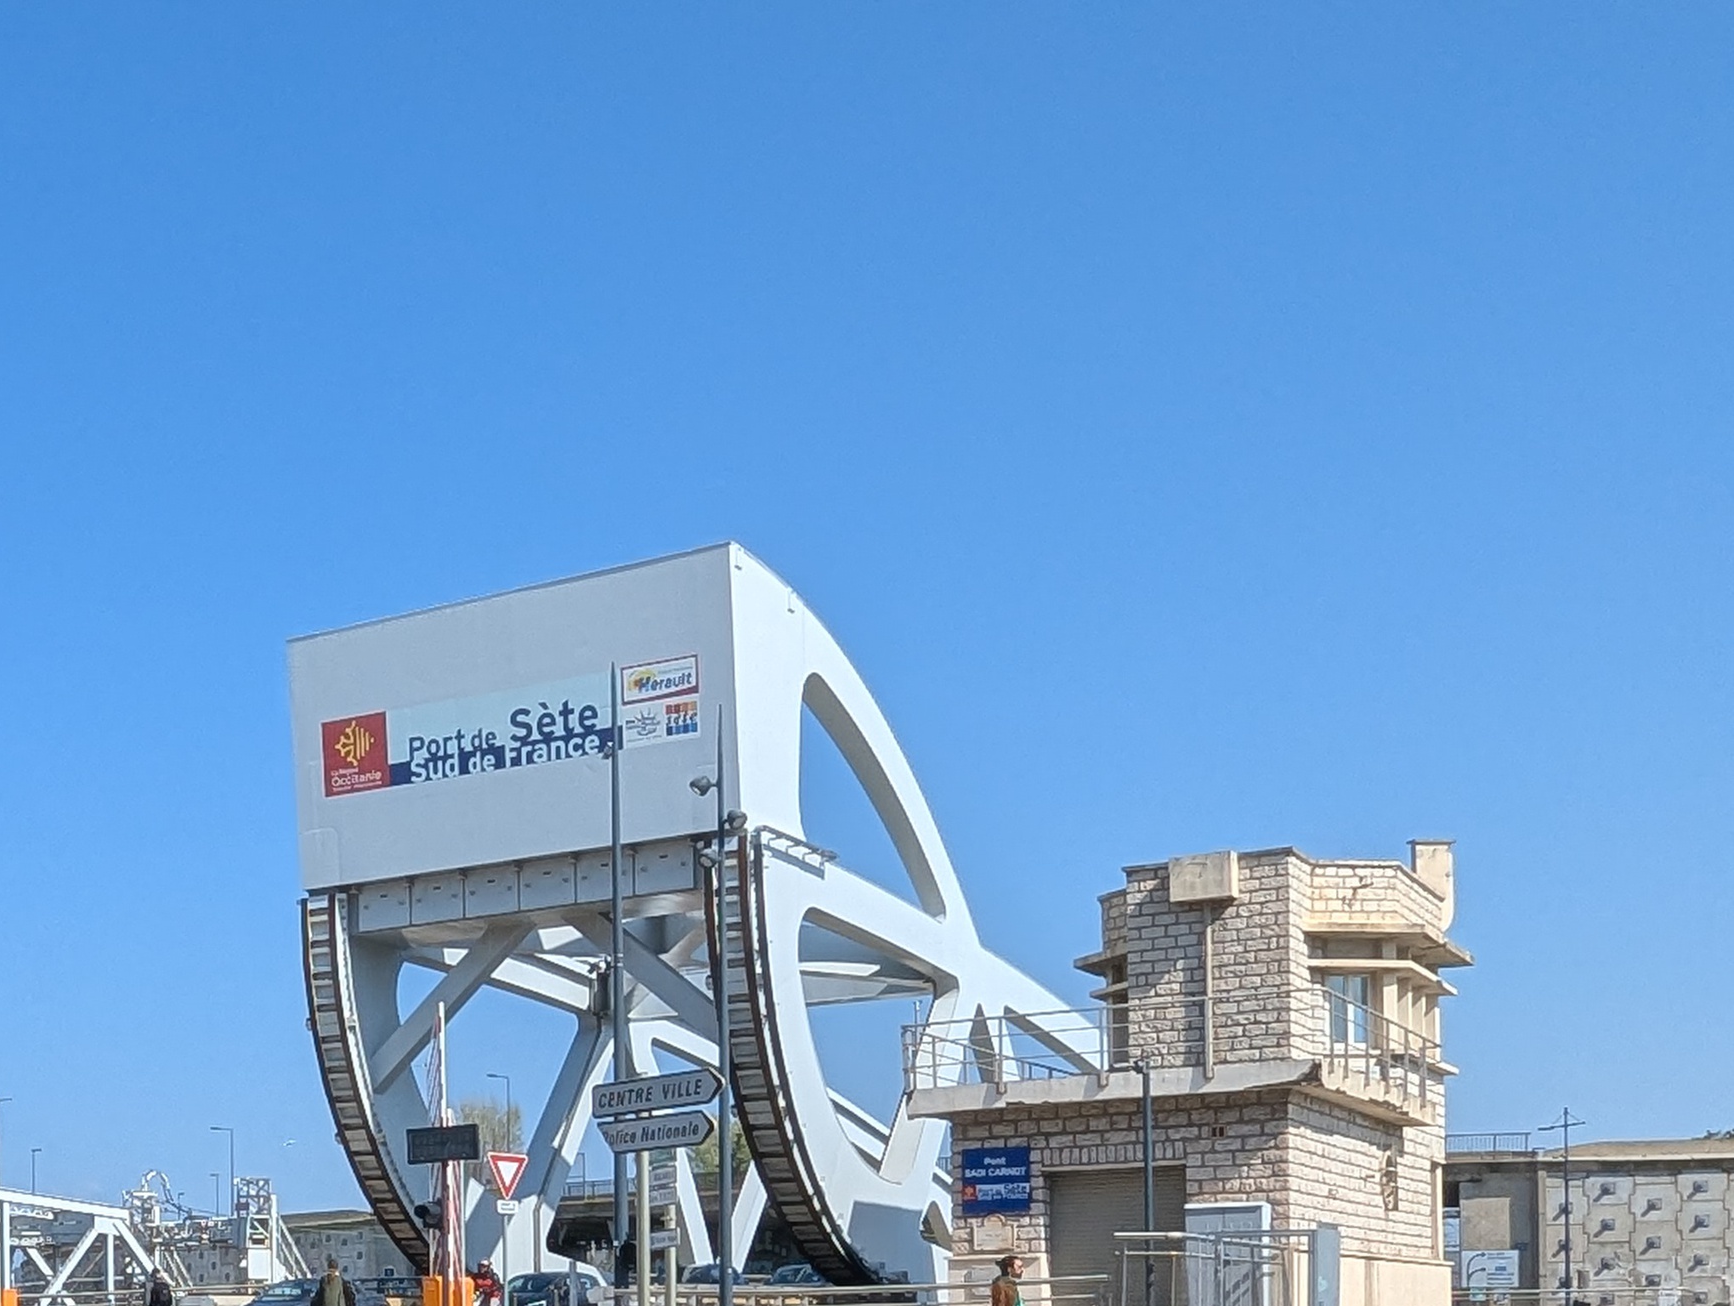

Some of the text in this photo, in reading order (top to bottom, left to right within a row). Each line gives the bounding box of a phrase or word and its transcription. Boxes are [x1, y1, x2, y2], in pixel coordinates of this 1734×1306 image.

[409, 699, 599, 760] Port de Sète
[411, 735, 601, 782] Sud de France
[598, 1079, 702, 1109] CENTRE VILLE
[641, 1121, 700, 1142] Nationale
[983, 1156, 1006, 1166] Pont
[988, 1166, 1027, 1177] CARNOT
